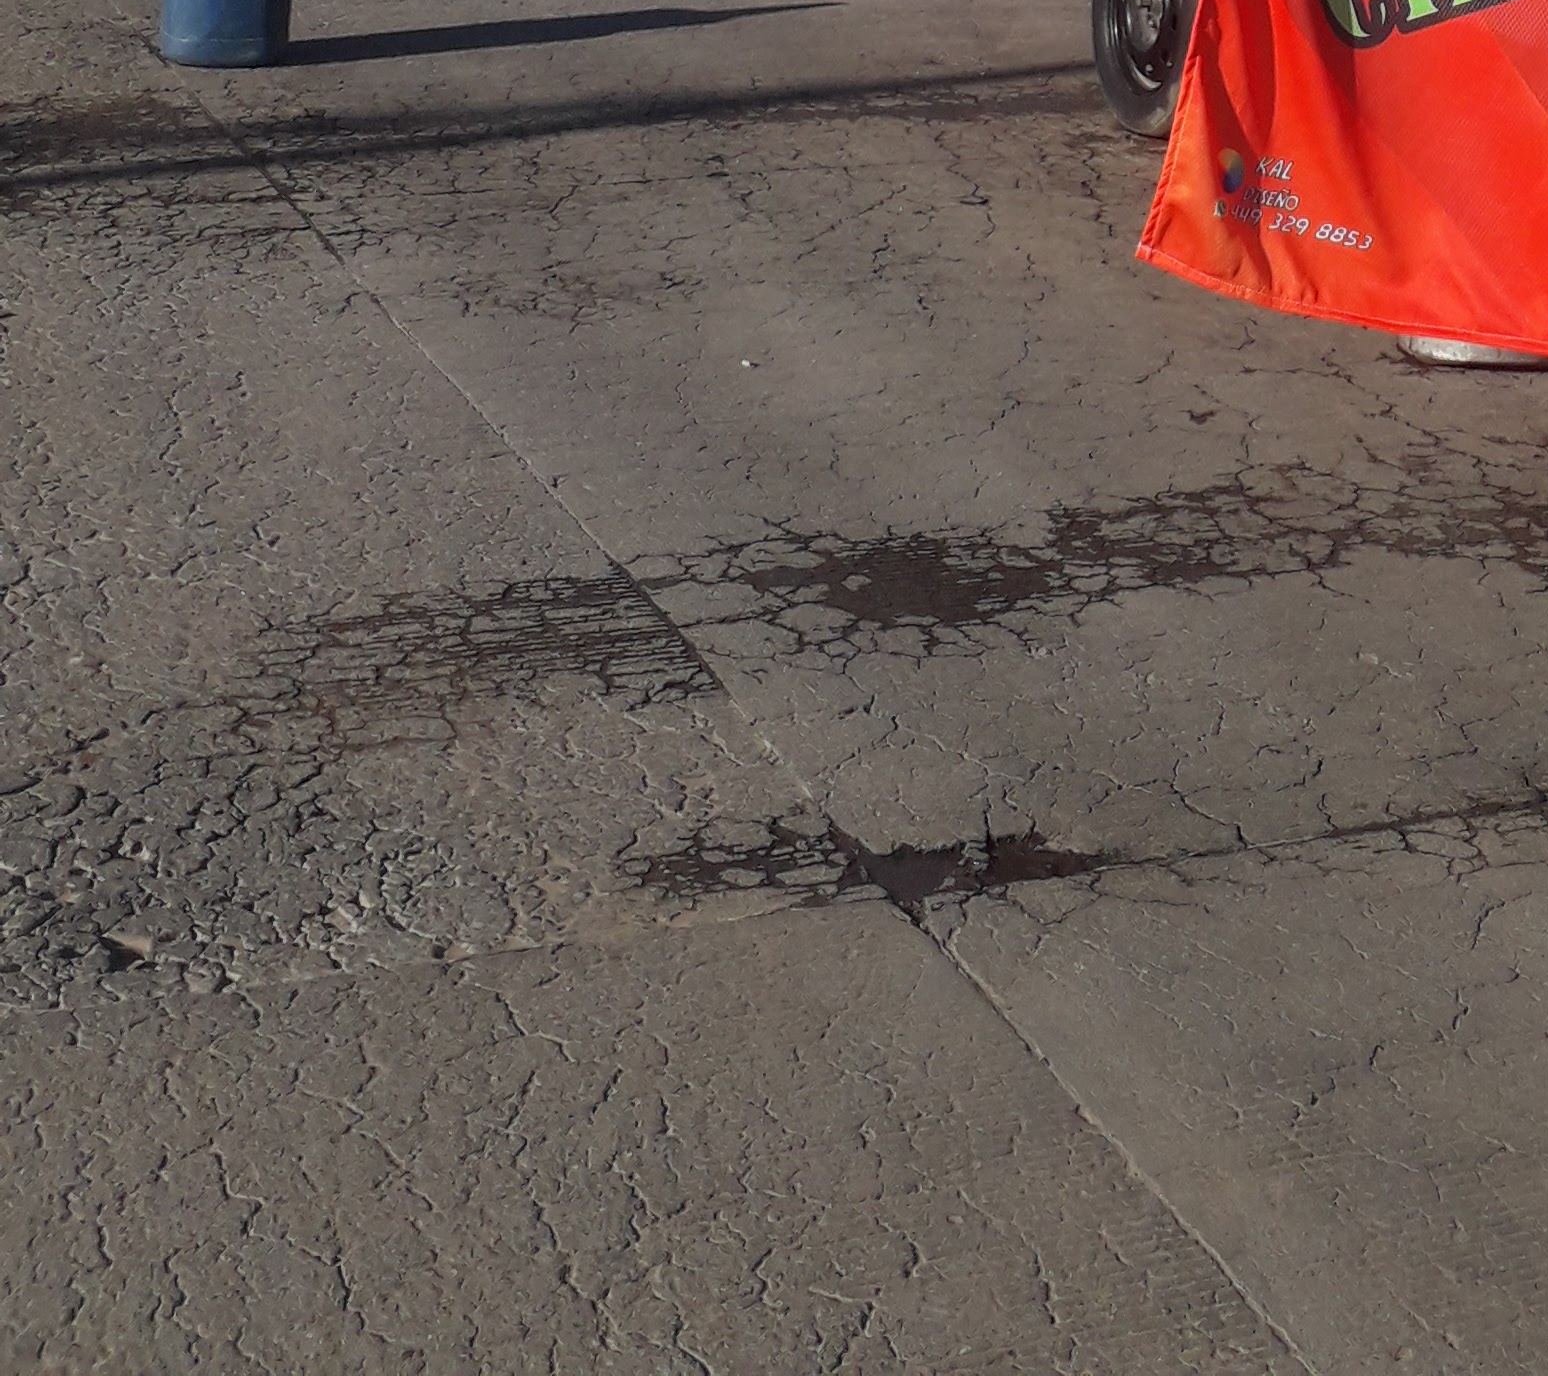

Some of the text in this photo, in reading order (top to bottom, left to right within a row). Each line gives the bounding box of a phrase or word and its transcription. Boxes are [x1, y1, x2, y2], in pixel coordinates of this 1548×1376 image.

[1256, 156, 1294, 180] KAL
[1243, 187, 1299, 211] DISEÑO
[1231, 204, 1373, 250] 449 329 8853
